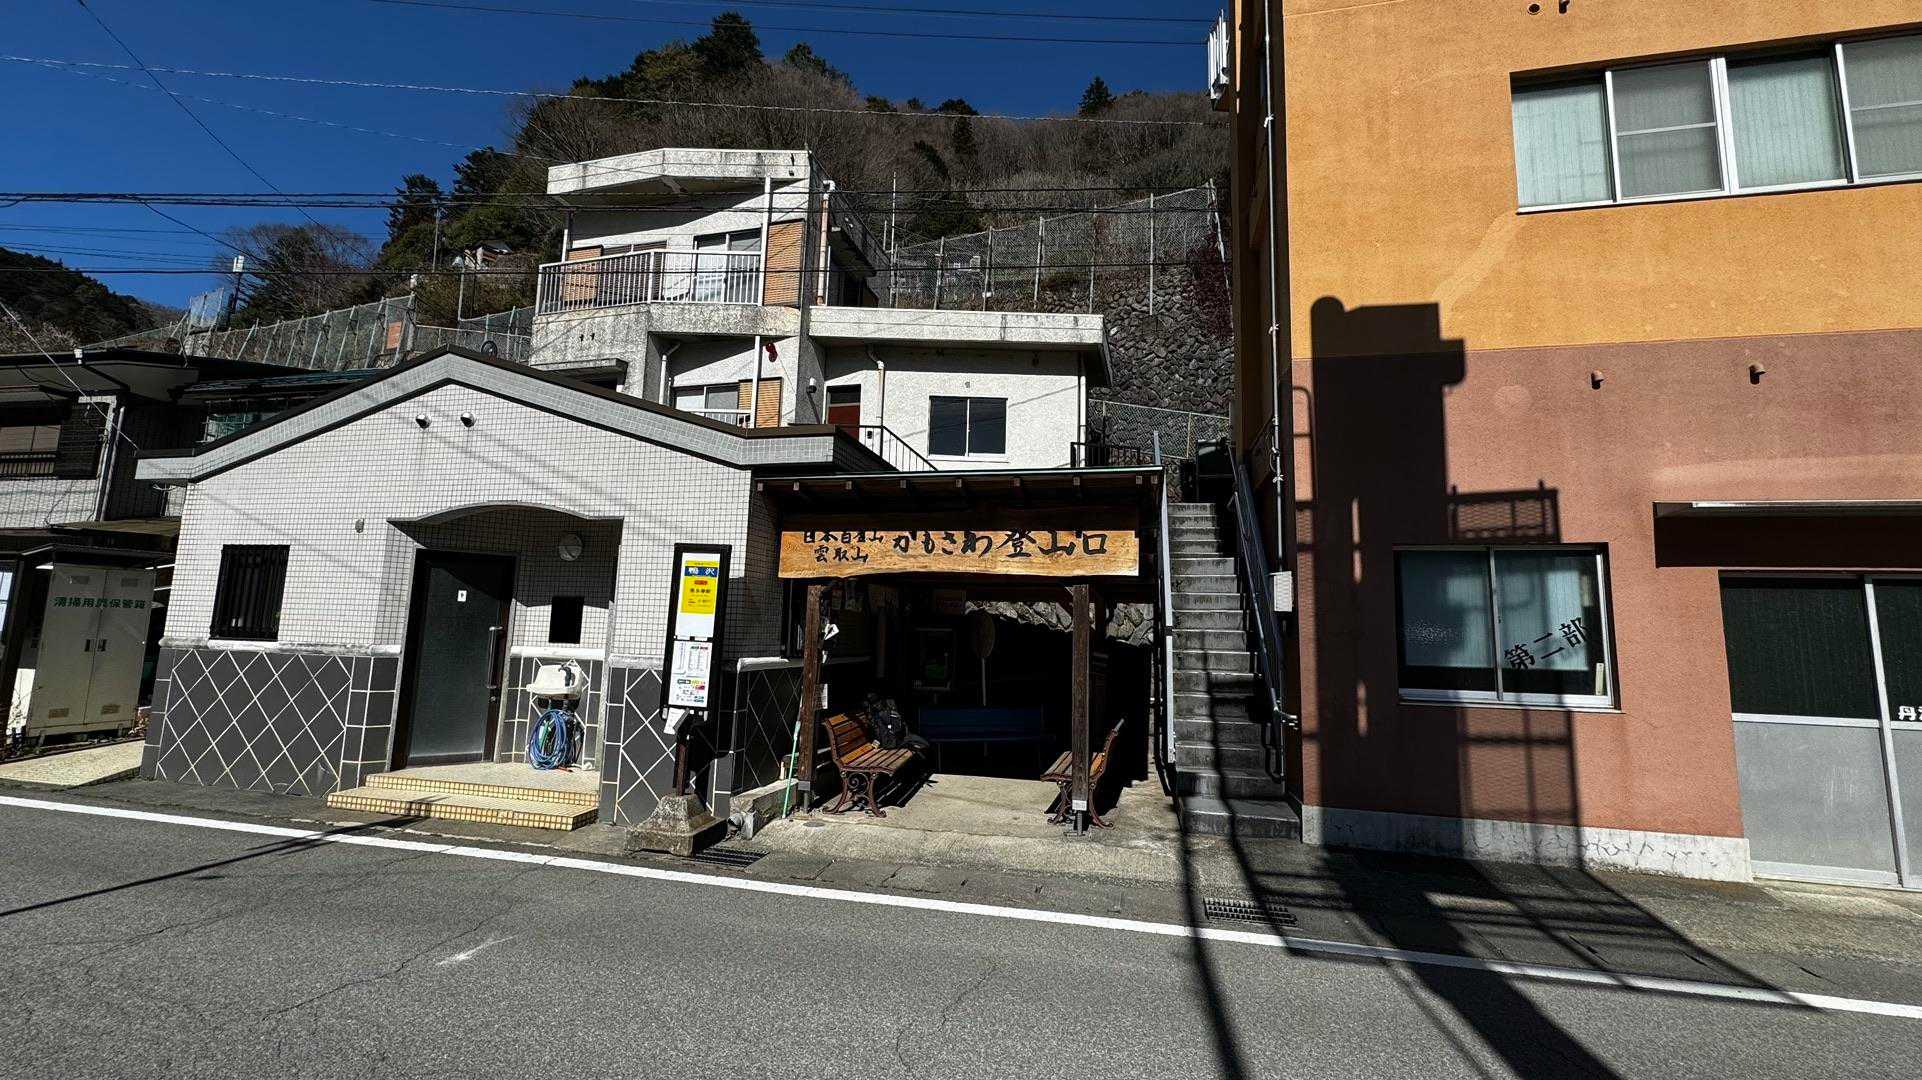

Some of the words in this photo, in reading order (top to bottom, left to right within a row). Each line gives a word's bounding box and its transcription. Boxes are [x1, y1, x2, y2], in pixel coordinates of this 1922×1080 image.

[814, 545, 869, 564] 雲取山
[892, 529, 1108, 557] かもさわ登山口
[1504, 618, 1587, 670] 第二部
